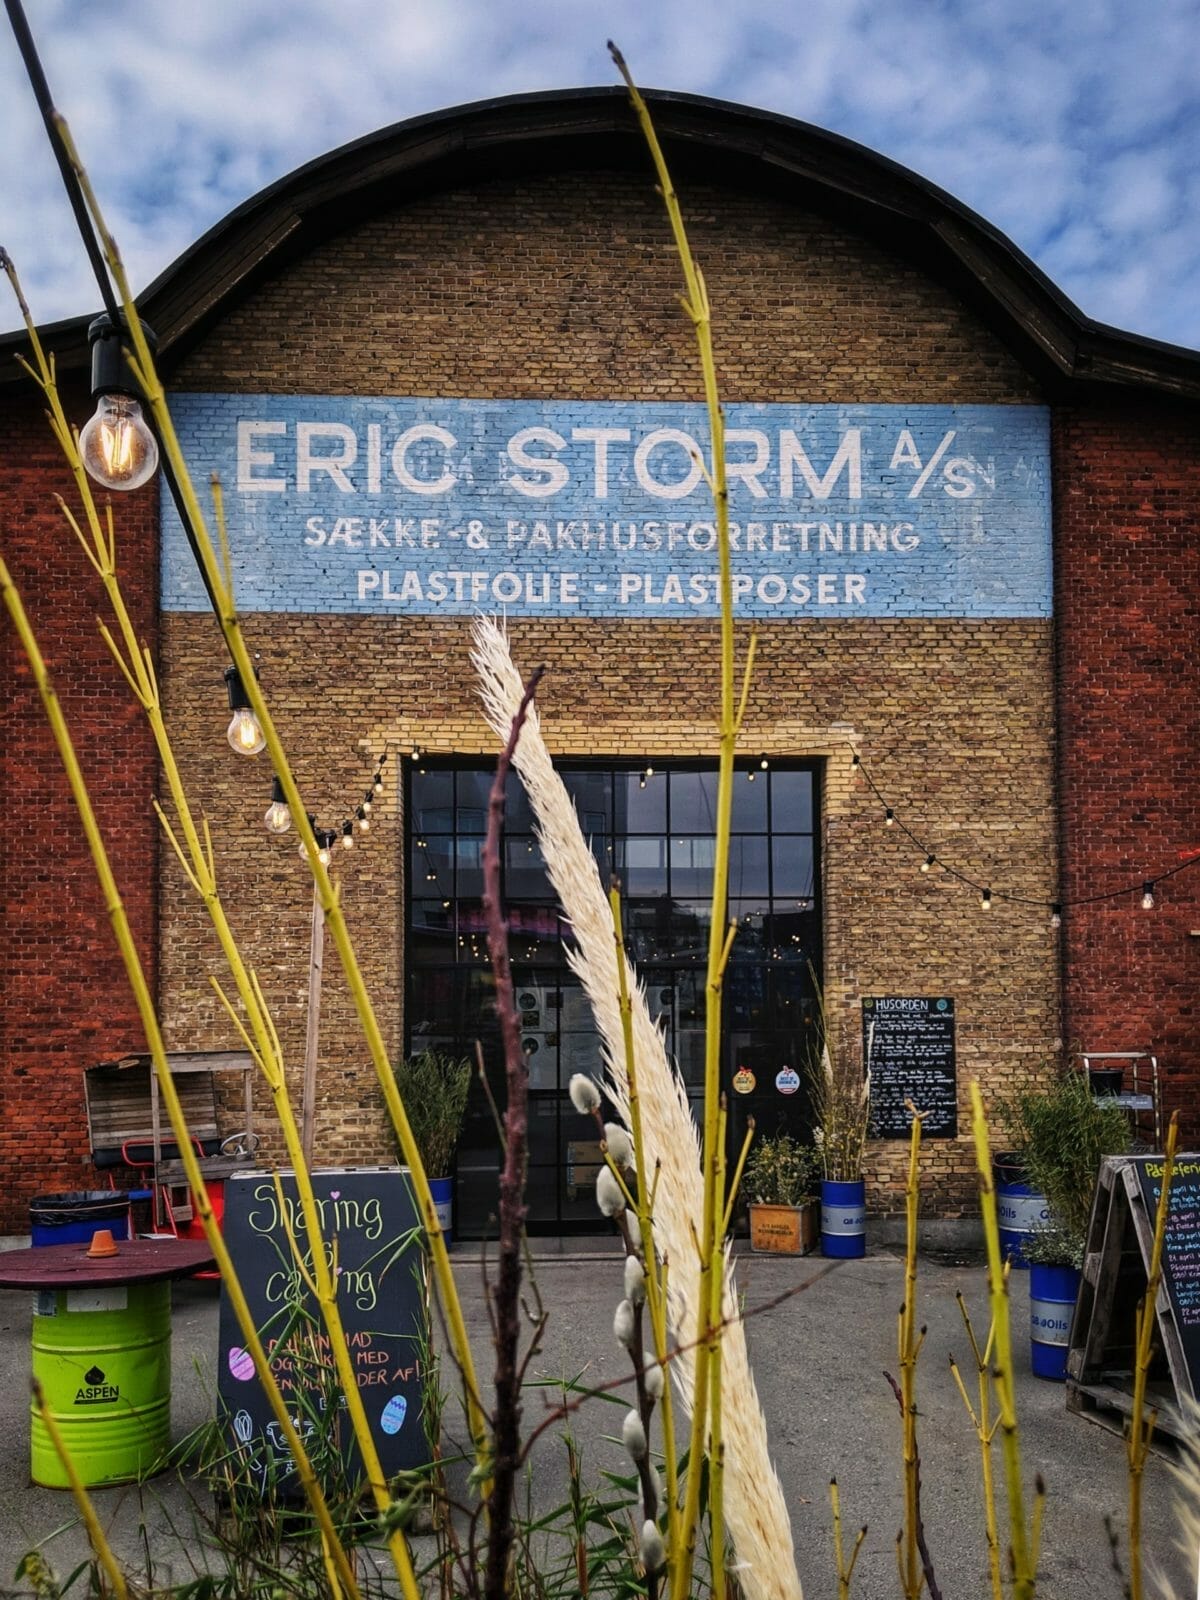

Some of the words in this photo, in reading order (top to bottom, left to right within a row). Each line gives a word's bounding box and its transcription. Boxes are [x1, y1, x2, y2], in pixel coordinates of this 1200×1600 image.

[236, 421, 459, 495] ERIC
[506, 426, 862, 499] STORM
[888, 428, 977, 499] A/S
[506, 520, 921, 552] PAKHUSFORRETNING
[357, 569, 580, 604] PLASTFOLIE
[620, 573, 868, 606] PLASTPOSER
[875, 999, 929, 1010] HUSORDEN
[356, 1351, 390, 1366] MED
[76, 1385, 120, 1400] ASPEN
